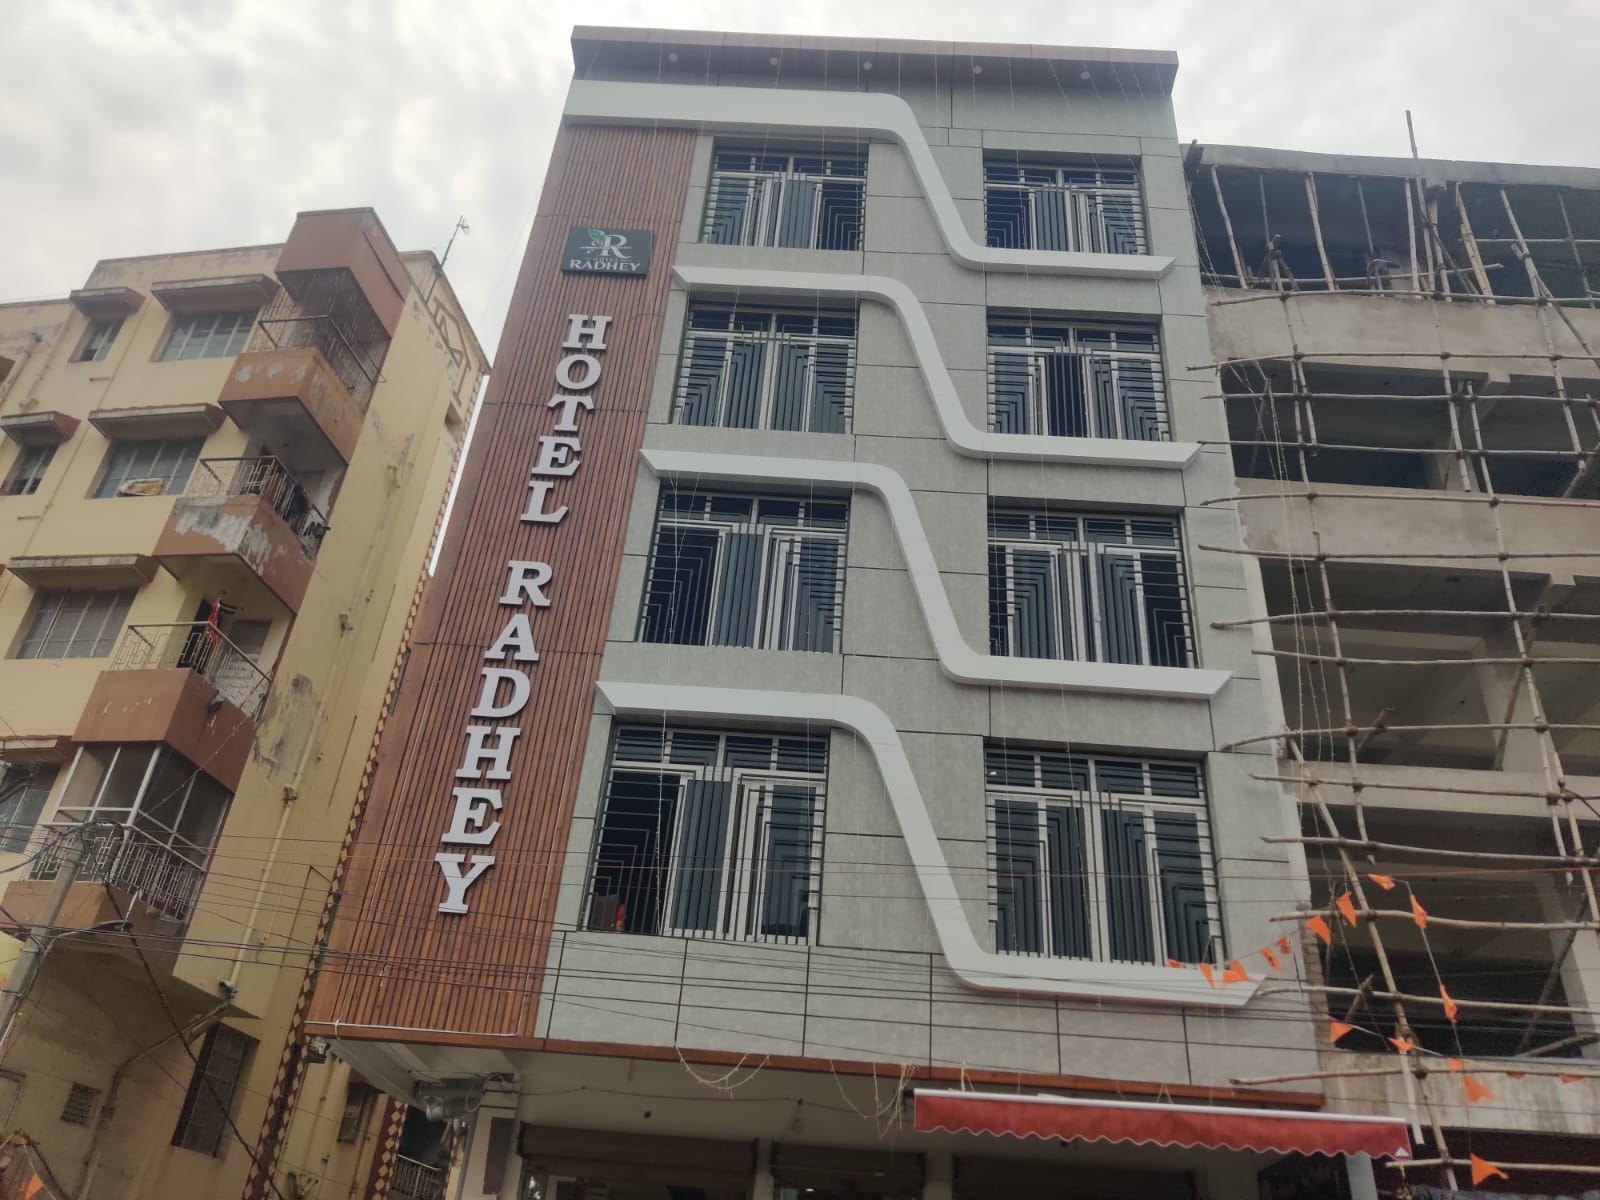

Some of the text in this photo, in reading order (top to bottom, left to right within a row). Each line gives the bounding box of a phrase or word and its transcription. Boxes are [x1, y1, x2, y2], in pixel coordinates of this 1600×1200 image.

[600, 234, 632, 259] R
[569, 259, 641, 271] RADHEY
[435, 314, 612, 914] HOTEL RADHEY
